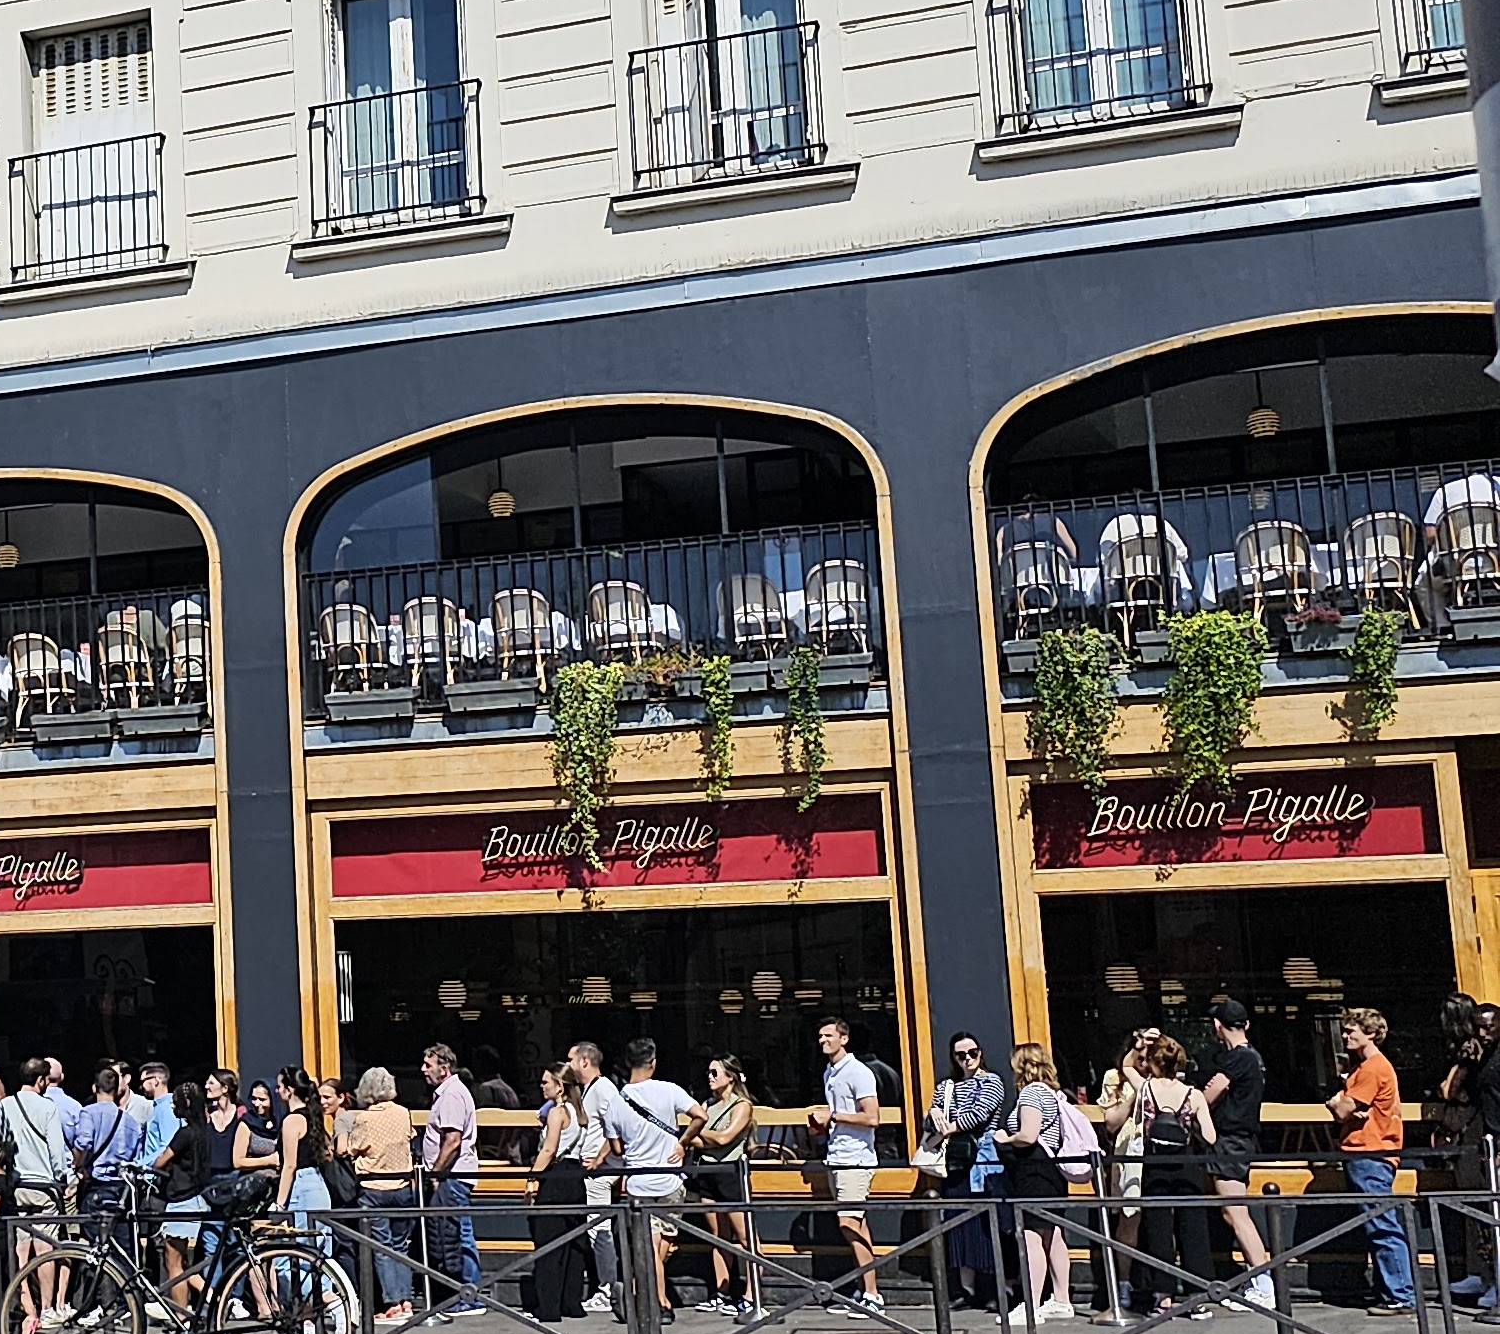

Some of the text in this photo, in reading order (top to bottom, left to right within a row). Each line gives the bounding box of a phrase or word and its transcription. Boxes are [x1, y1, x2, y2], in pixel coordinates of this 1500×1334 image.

[1086, 784, 1368, 843] Bouillon Pigalle
[611, 816, 716, 868] Pigalle
